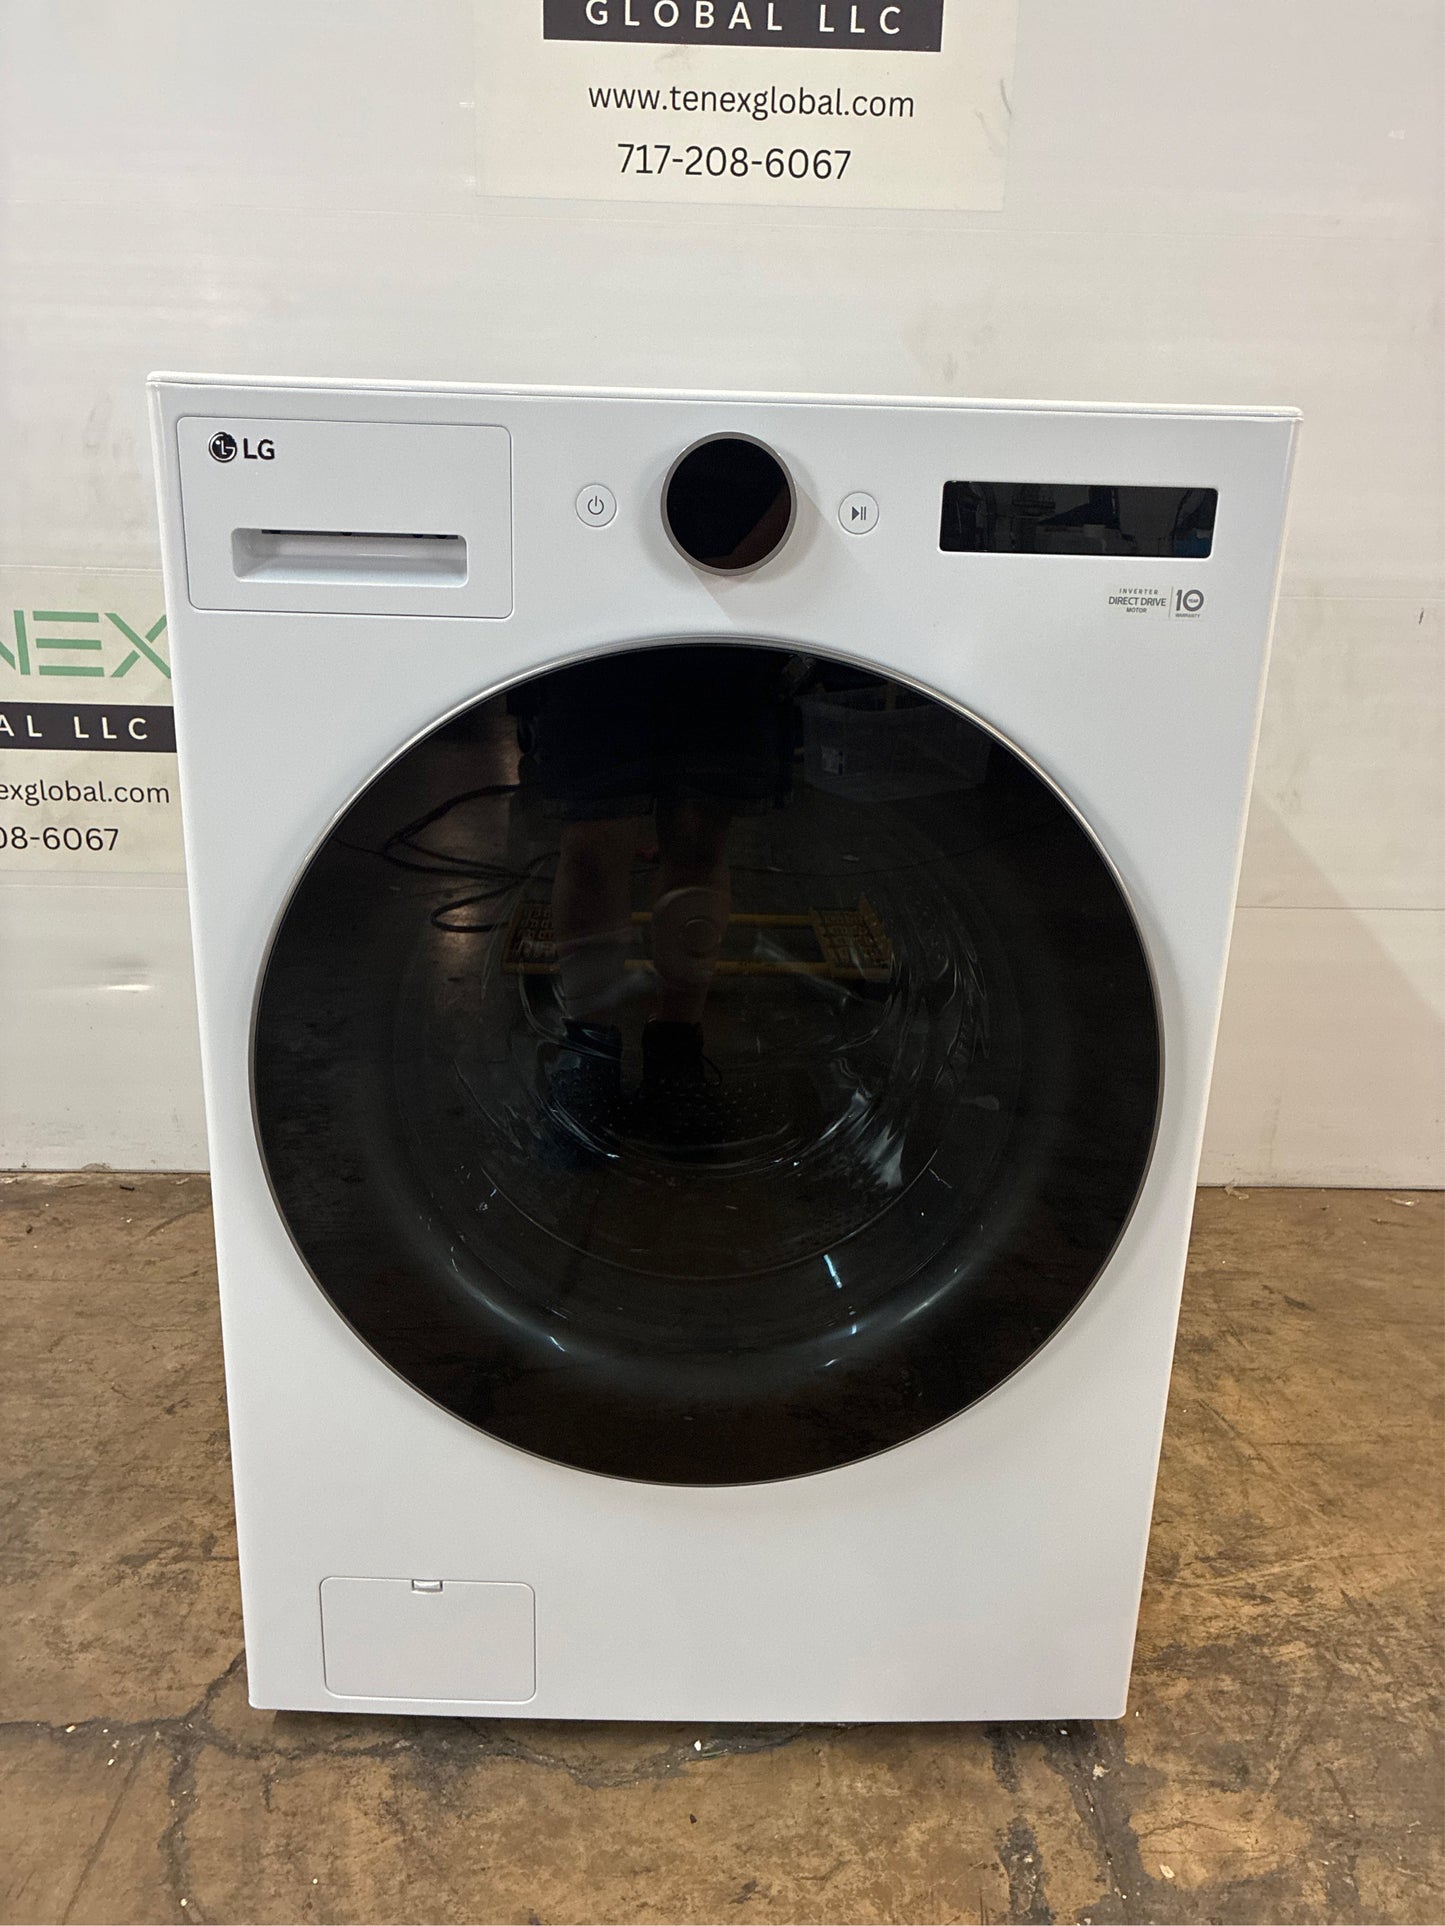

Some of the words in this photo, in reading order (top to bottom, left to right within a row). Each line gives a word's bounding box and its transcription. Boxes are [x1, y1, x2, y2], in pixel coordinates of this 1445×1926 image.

[585, 0, 783, 31] GLOBAL
[819, 4, 901, 35] LLC
[588, 86, 914, 121] www.tenexglobal.com
[617, 143, 851, 180] 717-208-6067
[243, 437, 276, 461] LG
[1108, 596, 1138, 606] DIRECT
[1140, 597, 1167, 607] DRIVE
[1175, 589, 1205, 612] 10
[73, 716, 149, 740] LLC
